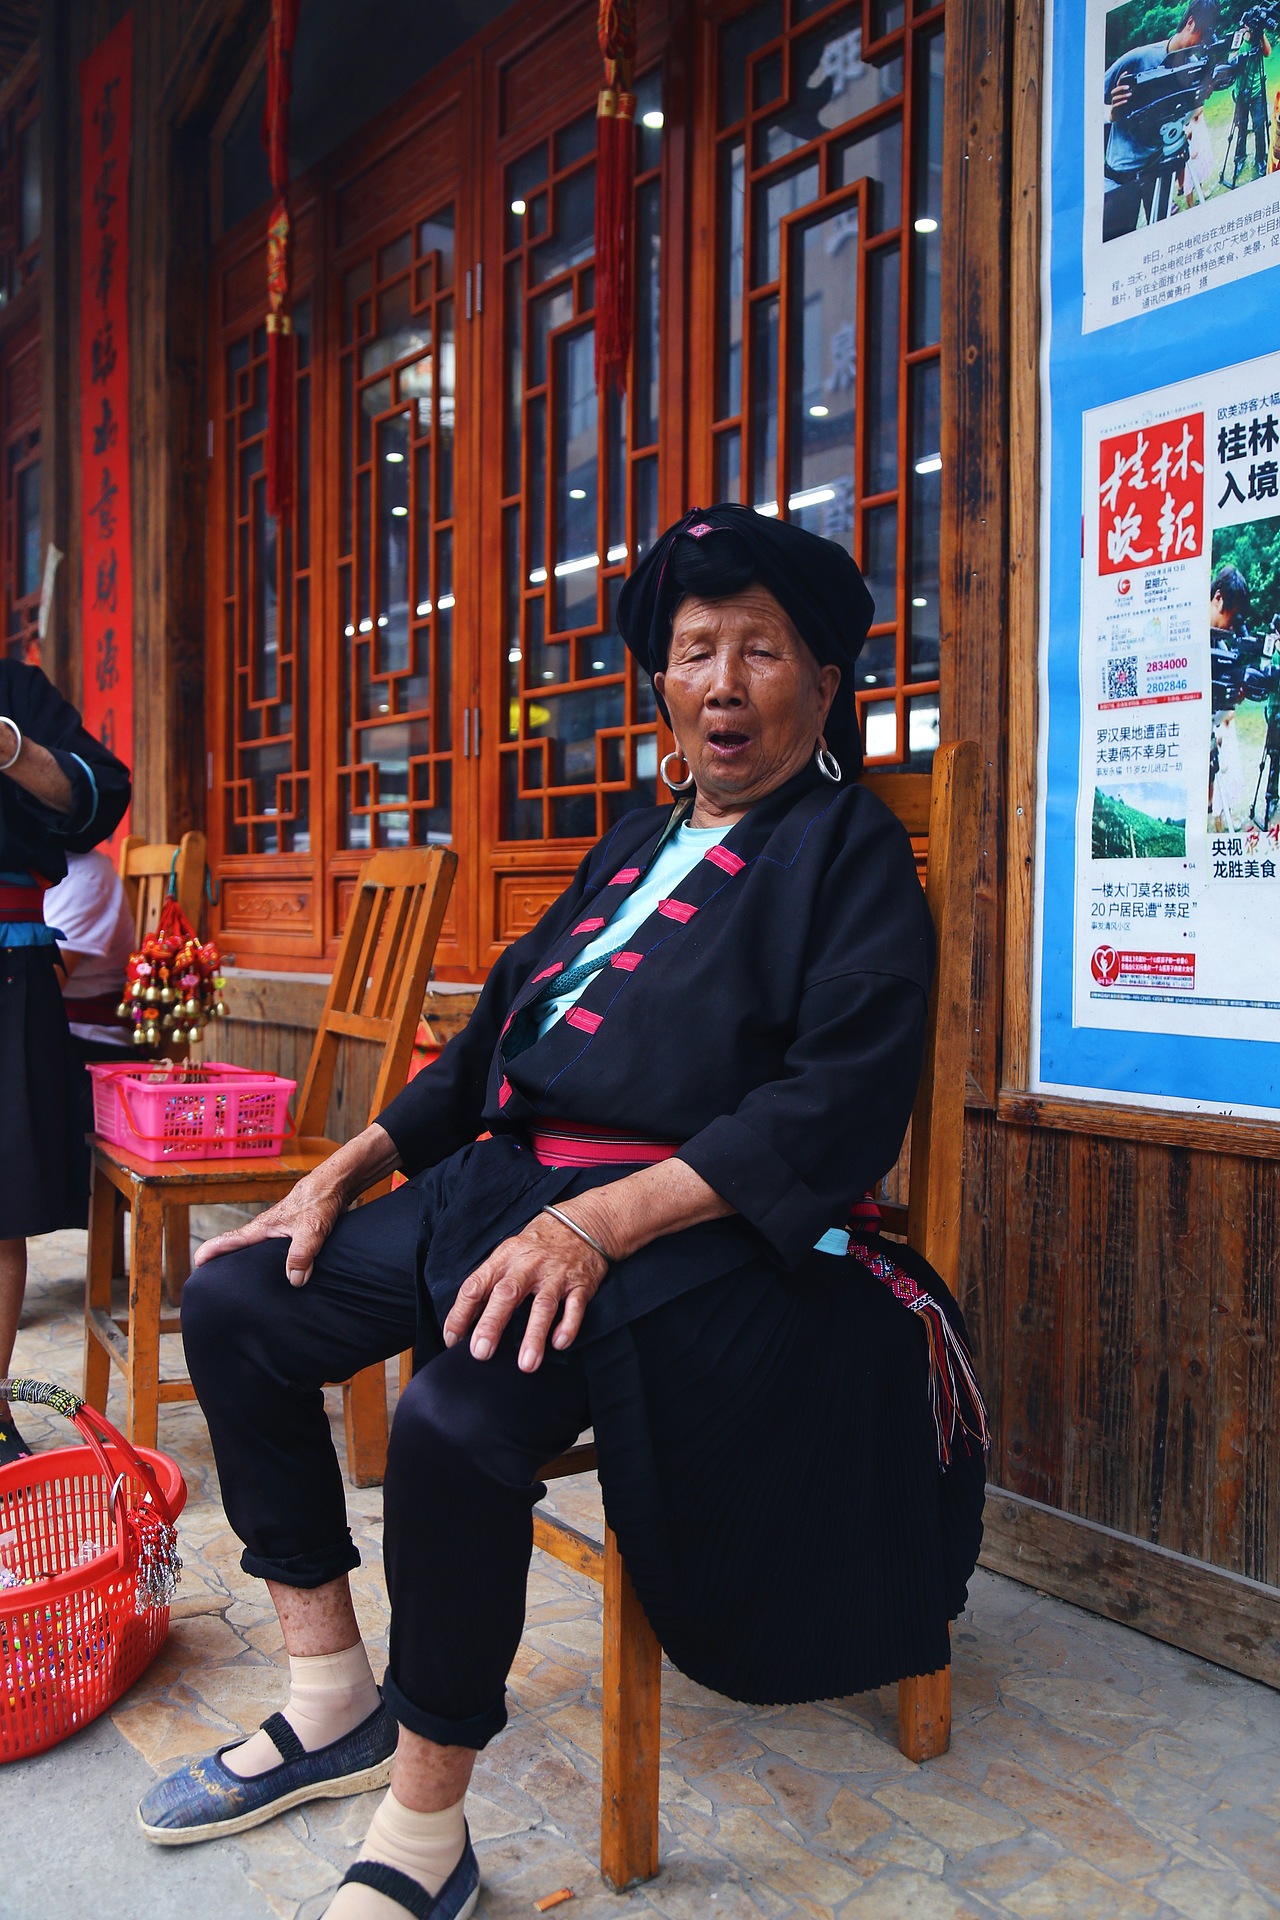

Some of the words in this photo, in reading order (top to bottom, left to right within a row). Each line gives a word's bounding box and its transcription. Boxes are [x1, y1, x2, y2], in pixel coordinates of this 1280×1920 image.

[1217, 413, 1280, 464] 桂林
[1099, 422, 1204, 513] 桂林
[1217, 460, 1279, 509] 入境
[1144, 576, 1169, 590] 星期六
[1146, 657, 1188, 673] 2834000
[1146, 679, 1188, 694] 2802846
[1096, 721, 1181, 745] 罗汉果地遭雷击
[1096, 742, 1180, 764] 夫妻俩不幸身亡
[1211, 838, 1243, 857] 央视
[1213, 859, 1277, 878] 龙胜美食
[1091, 882, 1190, 898] 一楼大门莫名被锁
